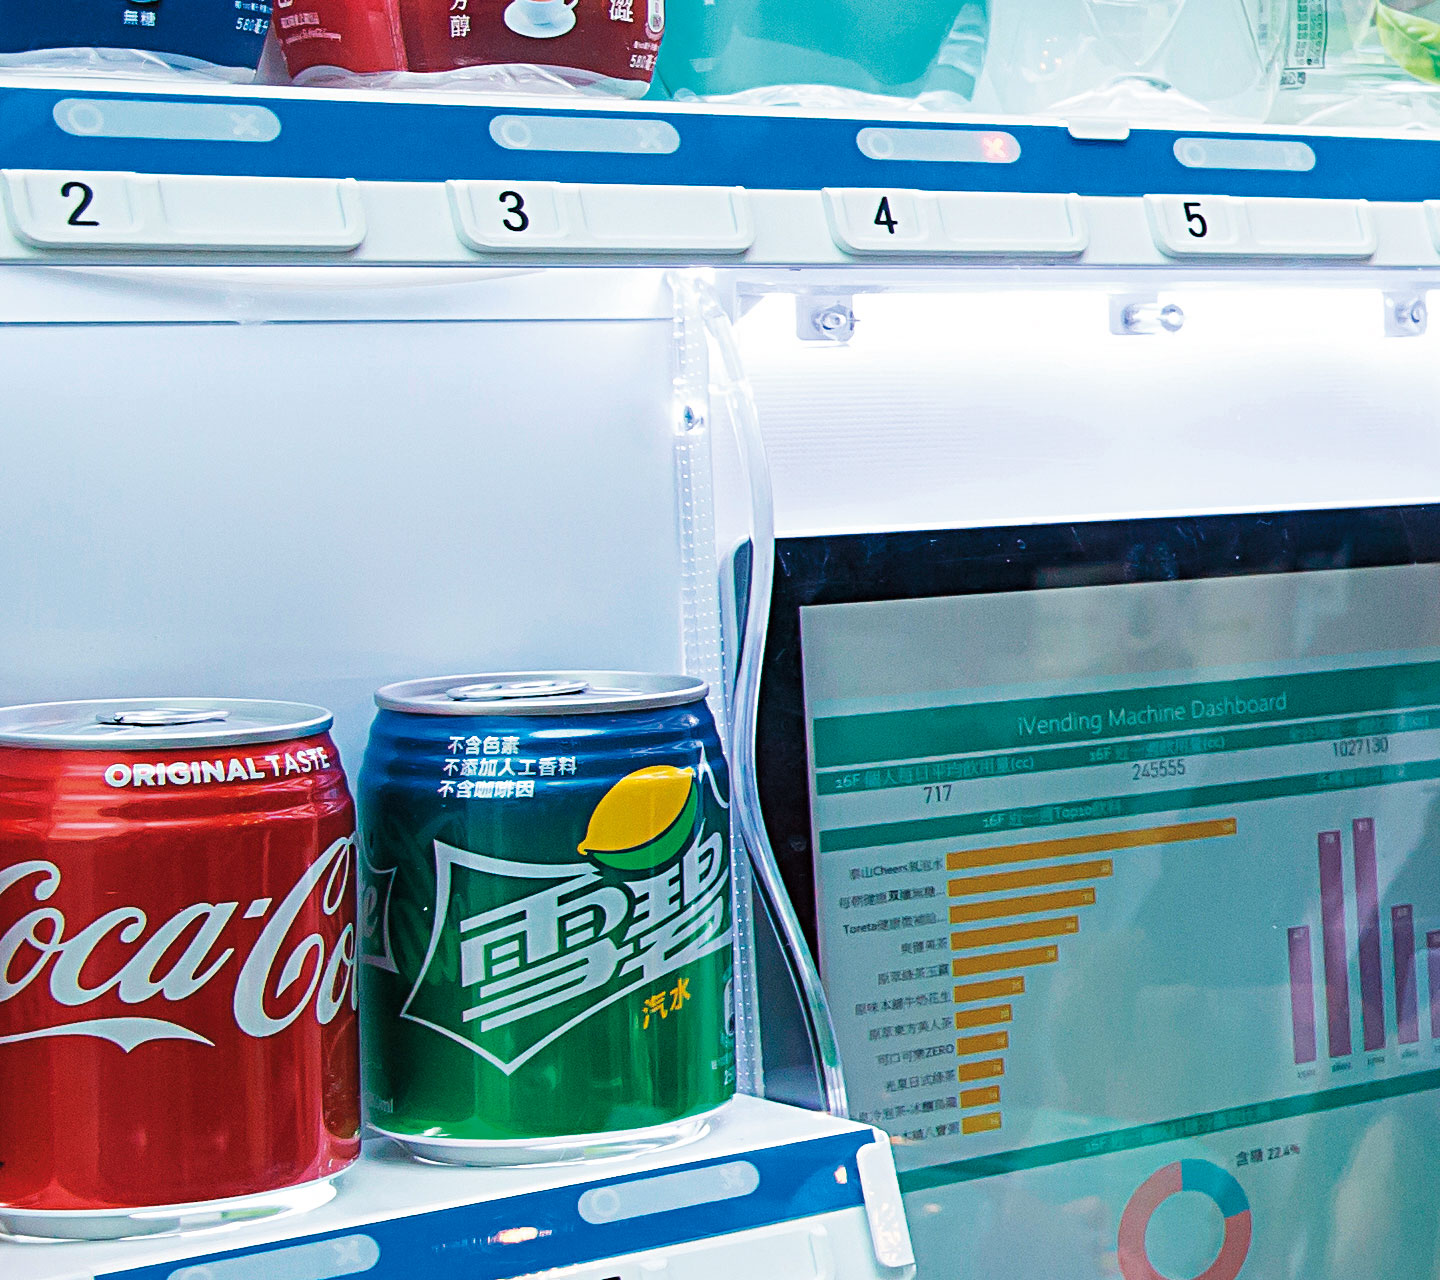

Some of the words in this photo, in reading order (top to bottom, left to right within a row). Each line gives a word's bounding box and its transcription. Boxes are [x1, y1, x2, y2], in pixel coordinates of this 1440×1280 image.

[123, 9, 157, 27] 無糖
[61, 181, 99, 227] 2
[500, 190, 530, 232] 3
[873, 195, 899, 235] 4
[1183, 202, 1208, 238] 5
[1018, 711, 1101, 736] iVending
[1108, 704, 1184, 727] Machine
[1191, 691, 1288, 718] Dashboard
[447, 735, 521, 756] 不含色素
[1331, 737, 1390, 758] 1027130
[104, 757, 266, 789] ORIGINAL
[268, 745, 332, 778] TASTE
[443, 756, 578, 777] 不添加人工香料
[1131, 759, 1186, 781] 245555
[437, 779, 536, 799] 不含咖啡因
[923, 784, 953, 804] 717
[460, 832, 730, 1033] 雪碧
[642, 977, 692, 1030] 汽水
